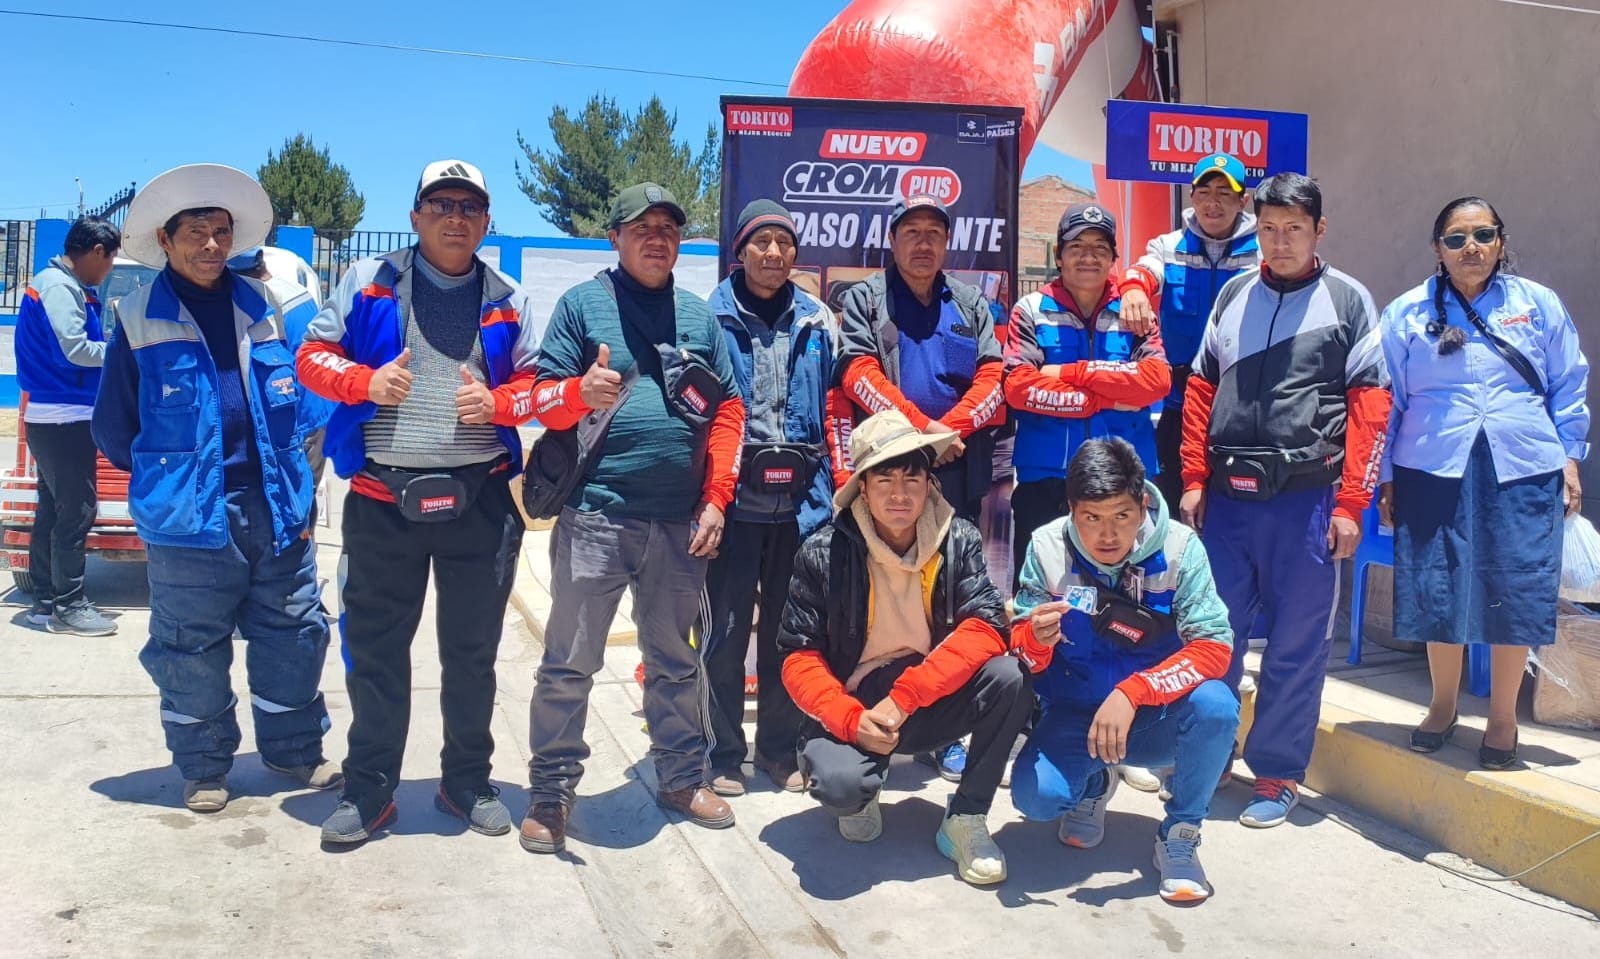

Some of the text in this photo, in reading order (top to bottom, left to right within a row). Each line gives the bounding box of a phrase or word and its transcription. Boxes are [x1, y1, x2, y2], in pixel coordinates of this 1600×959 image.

[730, 110, 790, 126] TORITO
[829, 134, 918, 157] NUEVO
[1155, 123, 1262, 157] TORITO
[784, 162, 953, 199] CROM PLUS
[1150, 161, 1196, 174] TU MEJ
[792, 211, 860, 249] PASO
[854, 380, 889, 414] ORITO
[1027, 386, 1085, 406] TORITO
